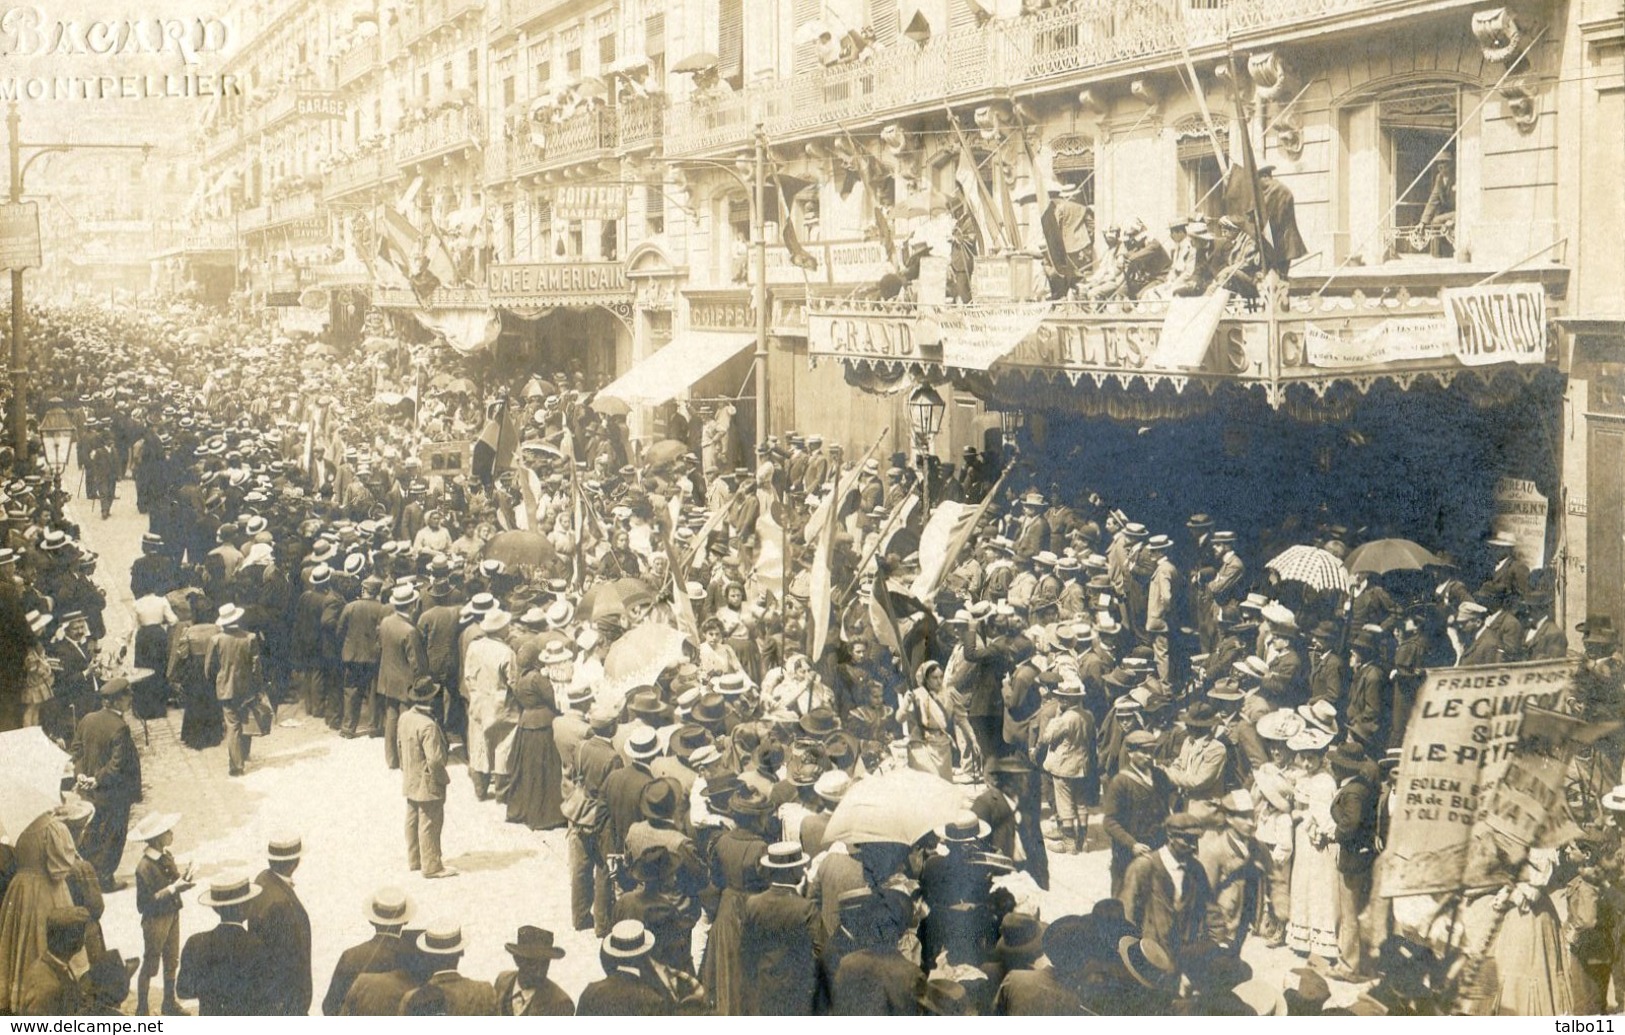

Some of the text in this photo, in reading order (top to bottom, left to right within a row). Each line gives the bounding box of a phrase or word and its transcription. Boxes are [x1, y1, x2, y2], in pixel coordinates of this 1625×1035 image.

[298, 98, 344, 115] GARAGE
[557, 186, 624, 209] COIFFEUR
[833, 246, 880, 265] PRODUCTION
[692, 303, 757, 327] COIFFEU
[1450, 292, 1543, 354] MONTADY
[830, 321, 914, 355] GRAND
[1422, 699, 1464, 719] LE
[1411, 744, 1447, 762] LE
